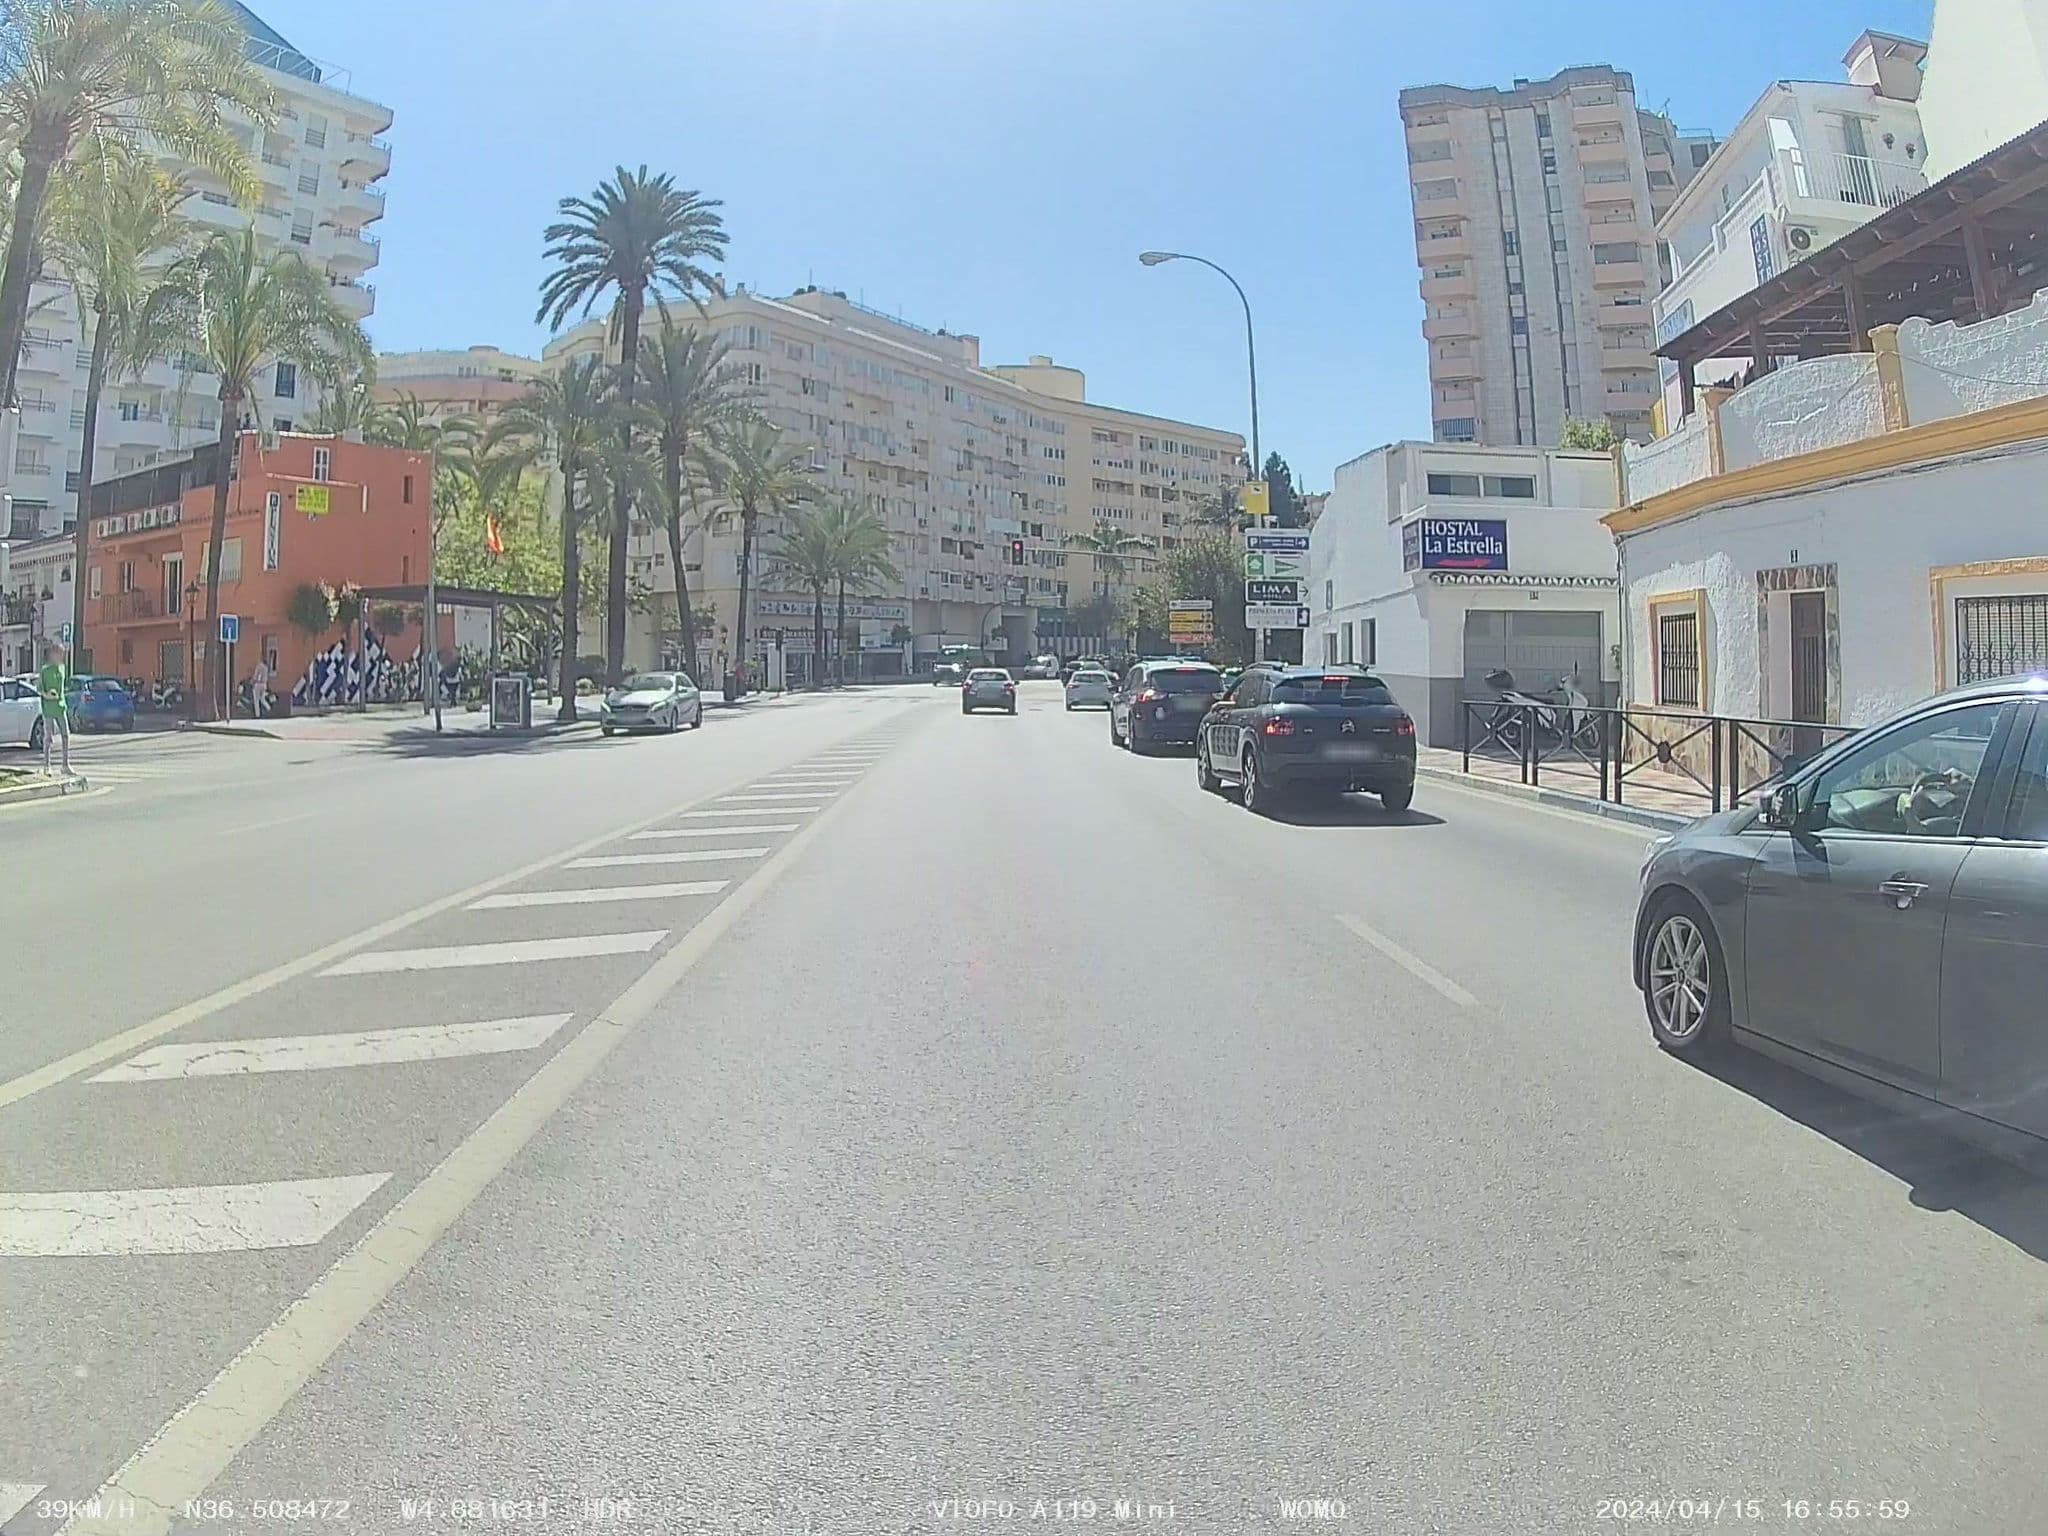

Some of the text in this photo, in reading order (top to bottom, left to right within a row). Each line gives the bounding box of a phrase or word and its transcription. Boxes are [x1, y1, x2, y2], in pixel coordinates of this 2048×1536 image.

[1424, 520, 1483, 537] HOSTAL
[1250, 537, 1258, 547] P
[1425, 536, 1503, 555] La Estrella
[1253, 584, 1291, 595] LIMA
